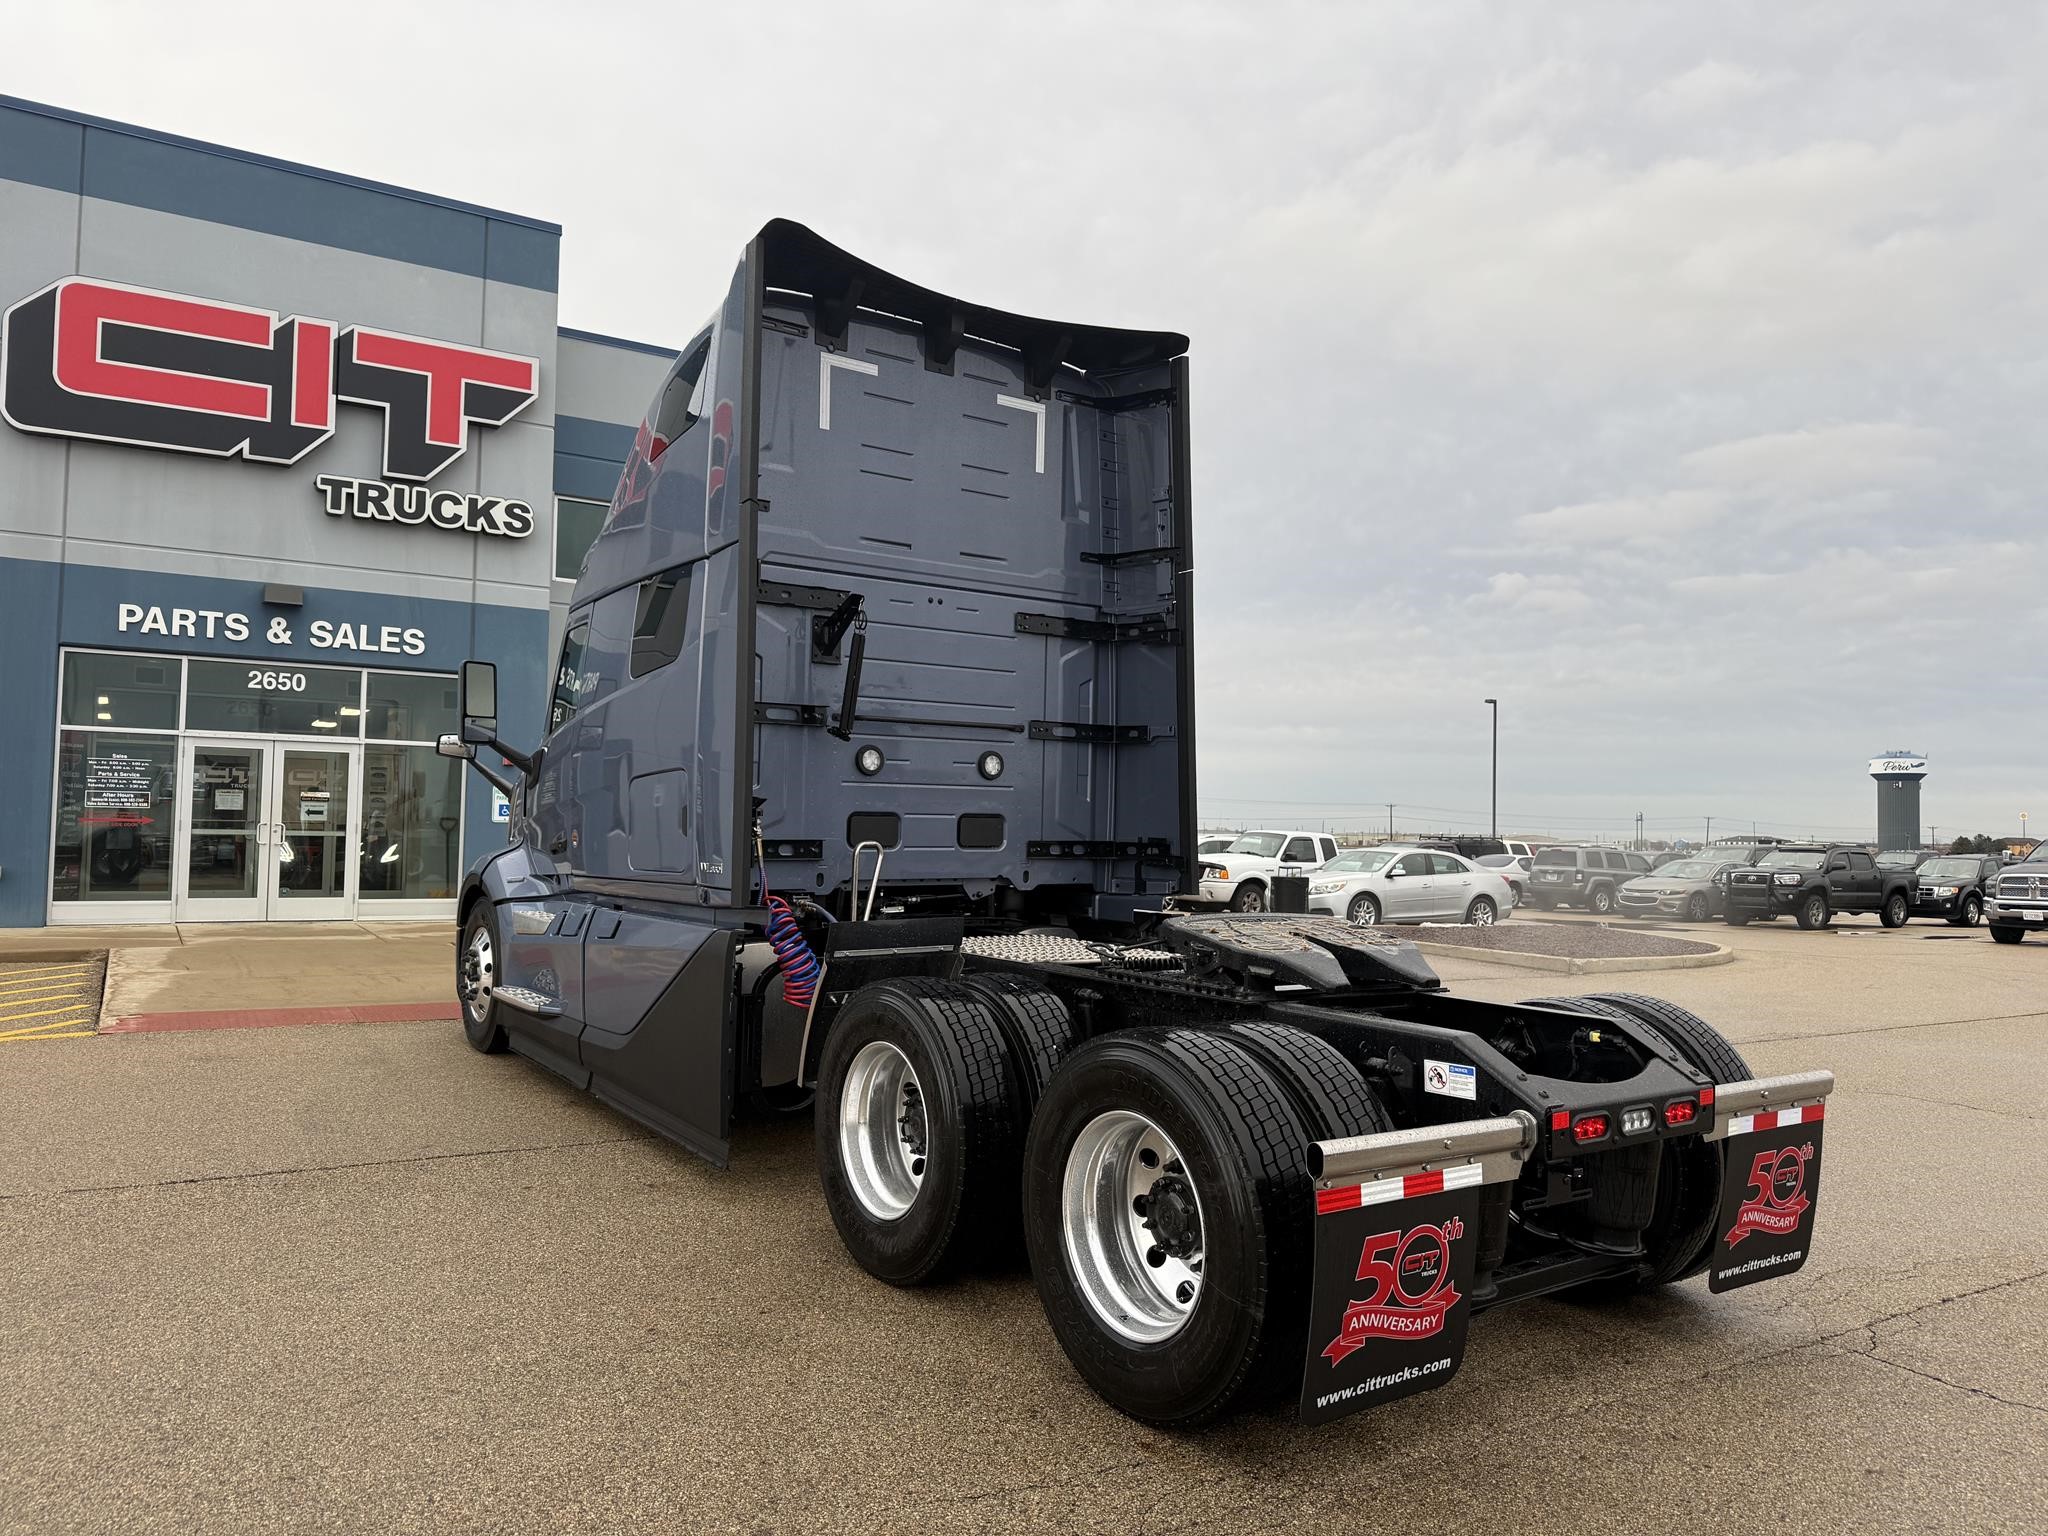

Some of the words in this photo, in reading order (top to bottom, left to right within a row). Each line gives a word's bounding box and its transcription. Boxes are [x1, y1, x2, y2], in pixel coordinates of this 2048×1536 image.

[1, 275, 540, 481] CIT
[316, 474, 535, 538] TRUCKS
[118, 603, 250, 641] PARTS
[266, 616, 293, 645] &
[309, 620, 426, 656] SALES
[247, 670, 307, 692] 2650
[1883, 760, 1910, 771] Peru
[1741, 1211, 1796, 1228] ANNIVERSARY
[1401, 1250, 1440, 1276] CIT
[1718, 1250, 1802, 1280] www.cittrucks.com
[1349, 1312, 1440, 1332] ANNIVERSARY
[1316, 1357, 1452, 1409] www.cittrucks.com
